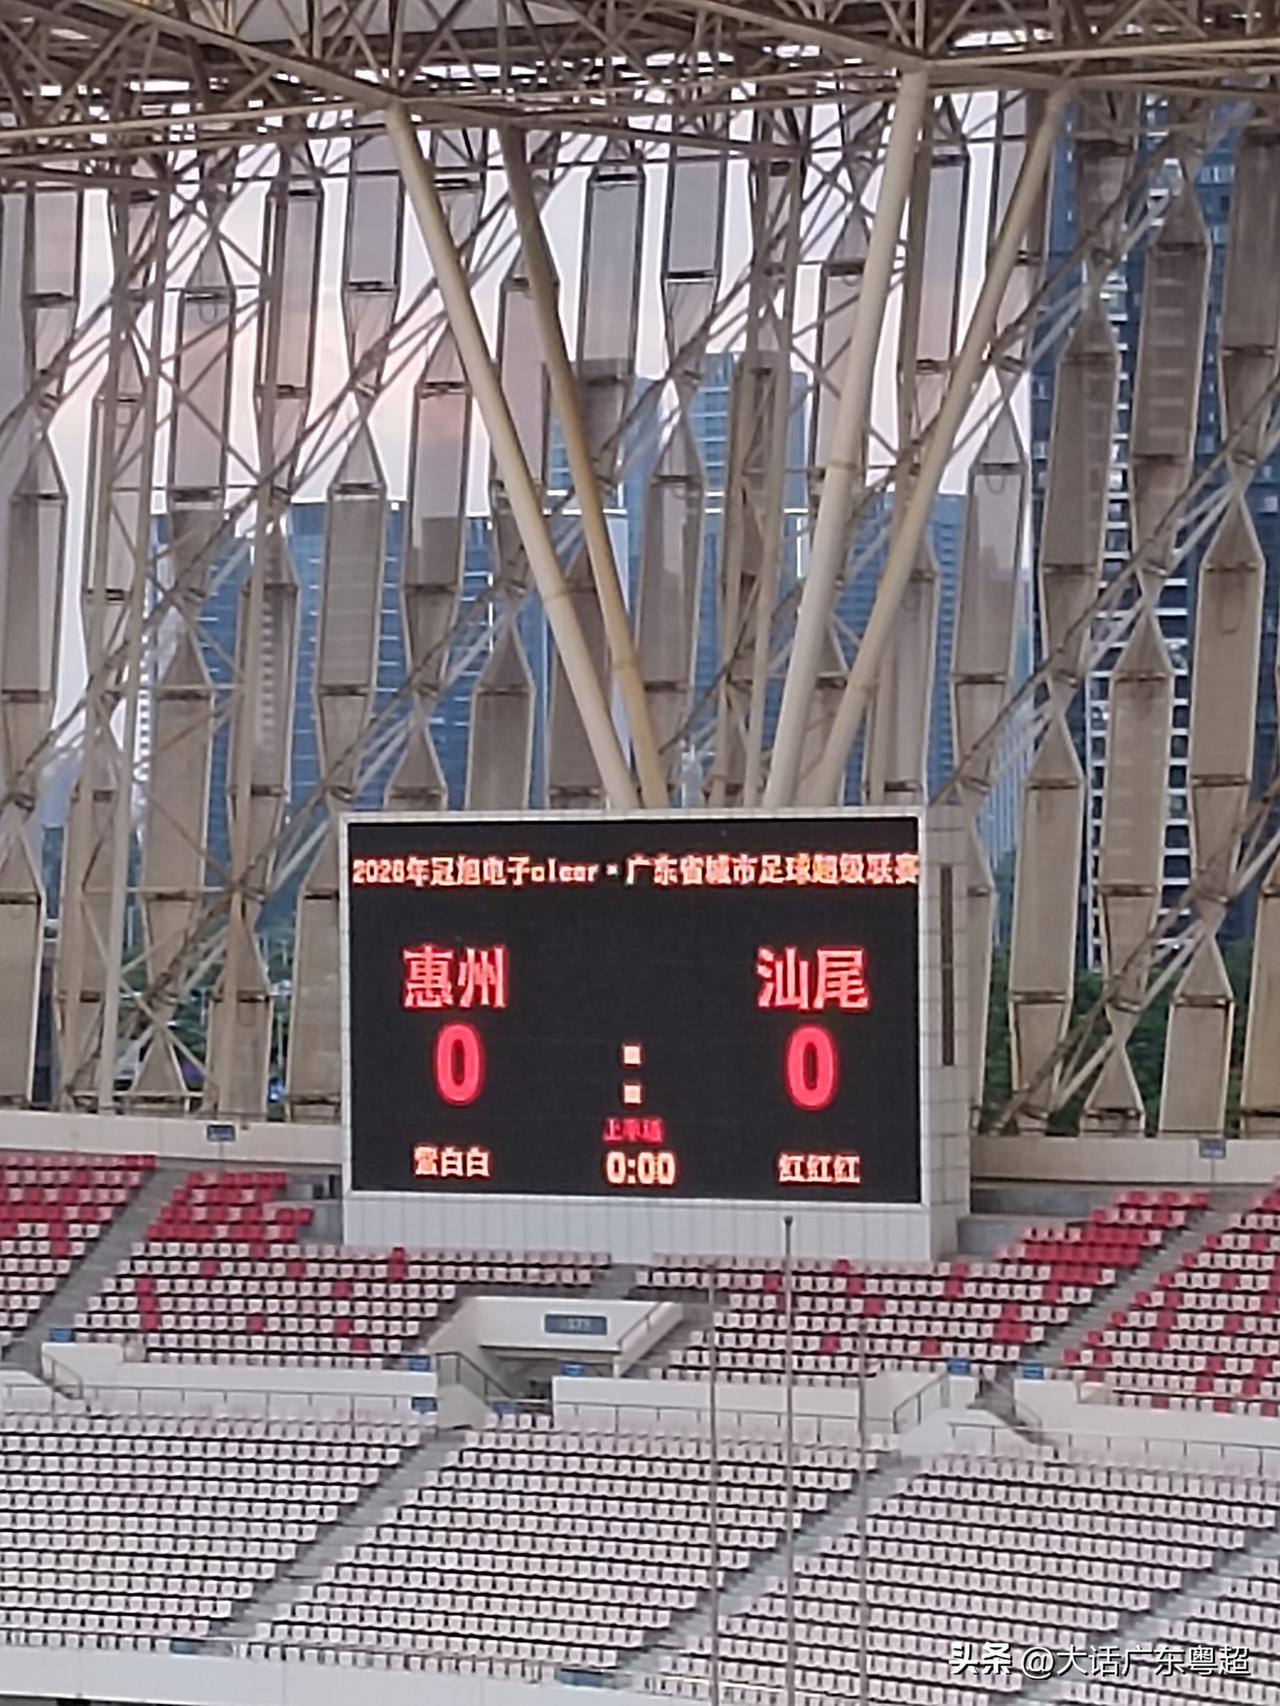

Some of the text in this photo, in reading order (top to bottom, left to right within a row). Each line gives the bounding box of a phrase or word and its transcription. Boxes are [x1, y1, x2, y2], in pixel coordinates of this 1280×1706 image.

[403, 944, 506, 1009] 惠州
[757, 947, 870, 1011] 汕尾
[435, 1024, 484, 1105] 0
[786, 1025, 838, 1110] 0
[606, 1151, 676, 1185] 0:00
[779, 1154, 861, 1183] 红红红
